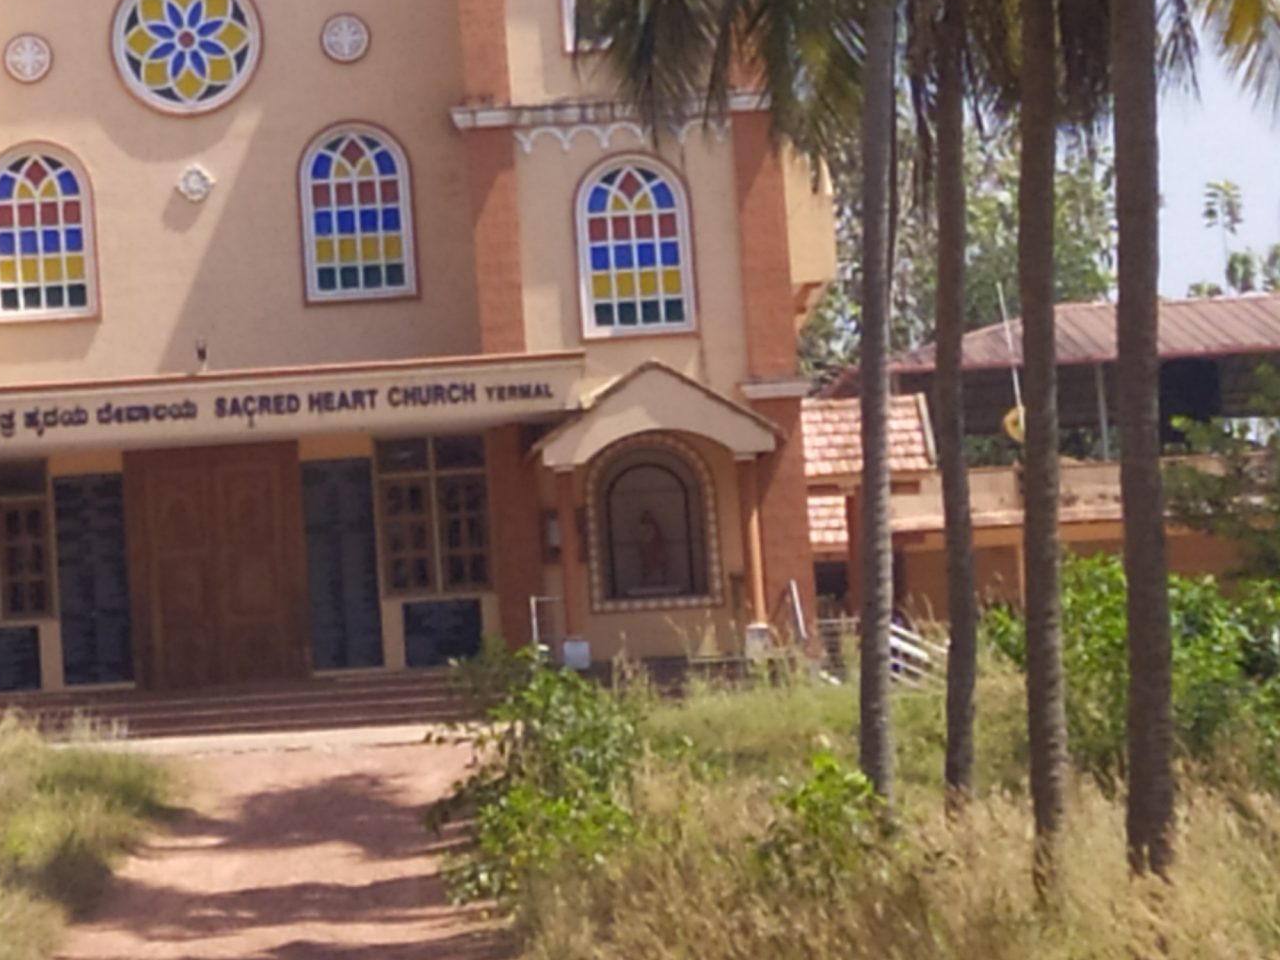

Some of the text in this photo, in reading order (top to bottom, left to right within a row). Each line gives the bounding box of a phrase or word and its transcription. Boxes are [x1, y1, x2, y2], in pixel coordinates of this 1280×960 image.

[214, 383, 554, 417] SACRED HEART CHURCH YERMAL
